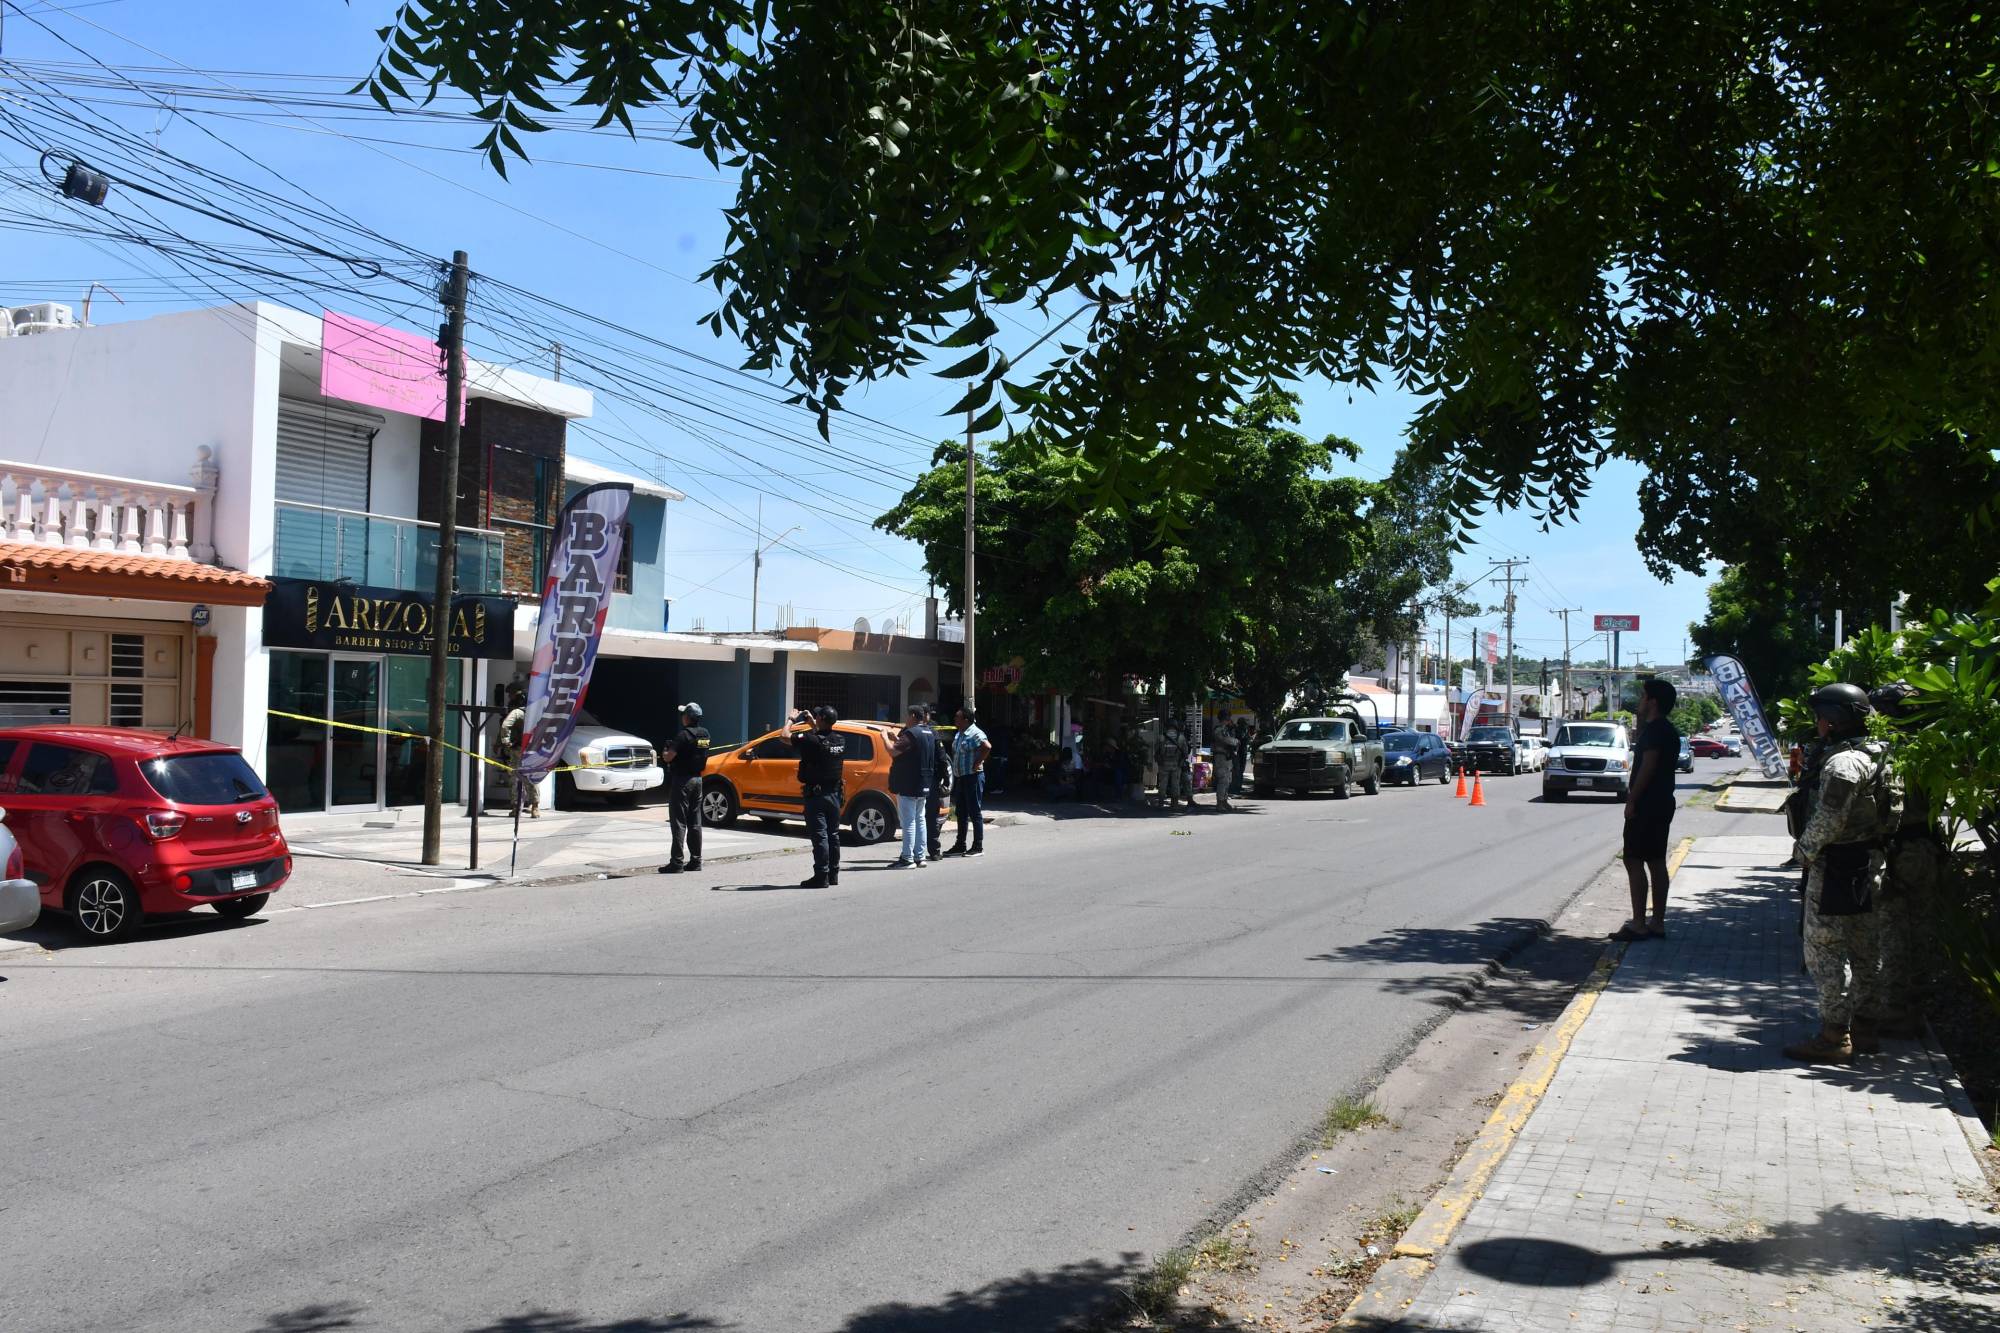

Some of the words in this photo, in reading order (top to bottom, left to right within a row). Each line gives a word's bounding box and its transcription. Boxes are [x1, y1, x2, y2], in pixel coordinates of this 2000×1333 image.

[323, 595, 470, 638] ARIZOA
[527, 509, 607, 754] BARBER
[335, 636, 381, 648] BARBER
[384, 639, 413, 650] SHOP
[418, 640, 460, 652] STIO
